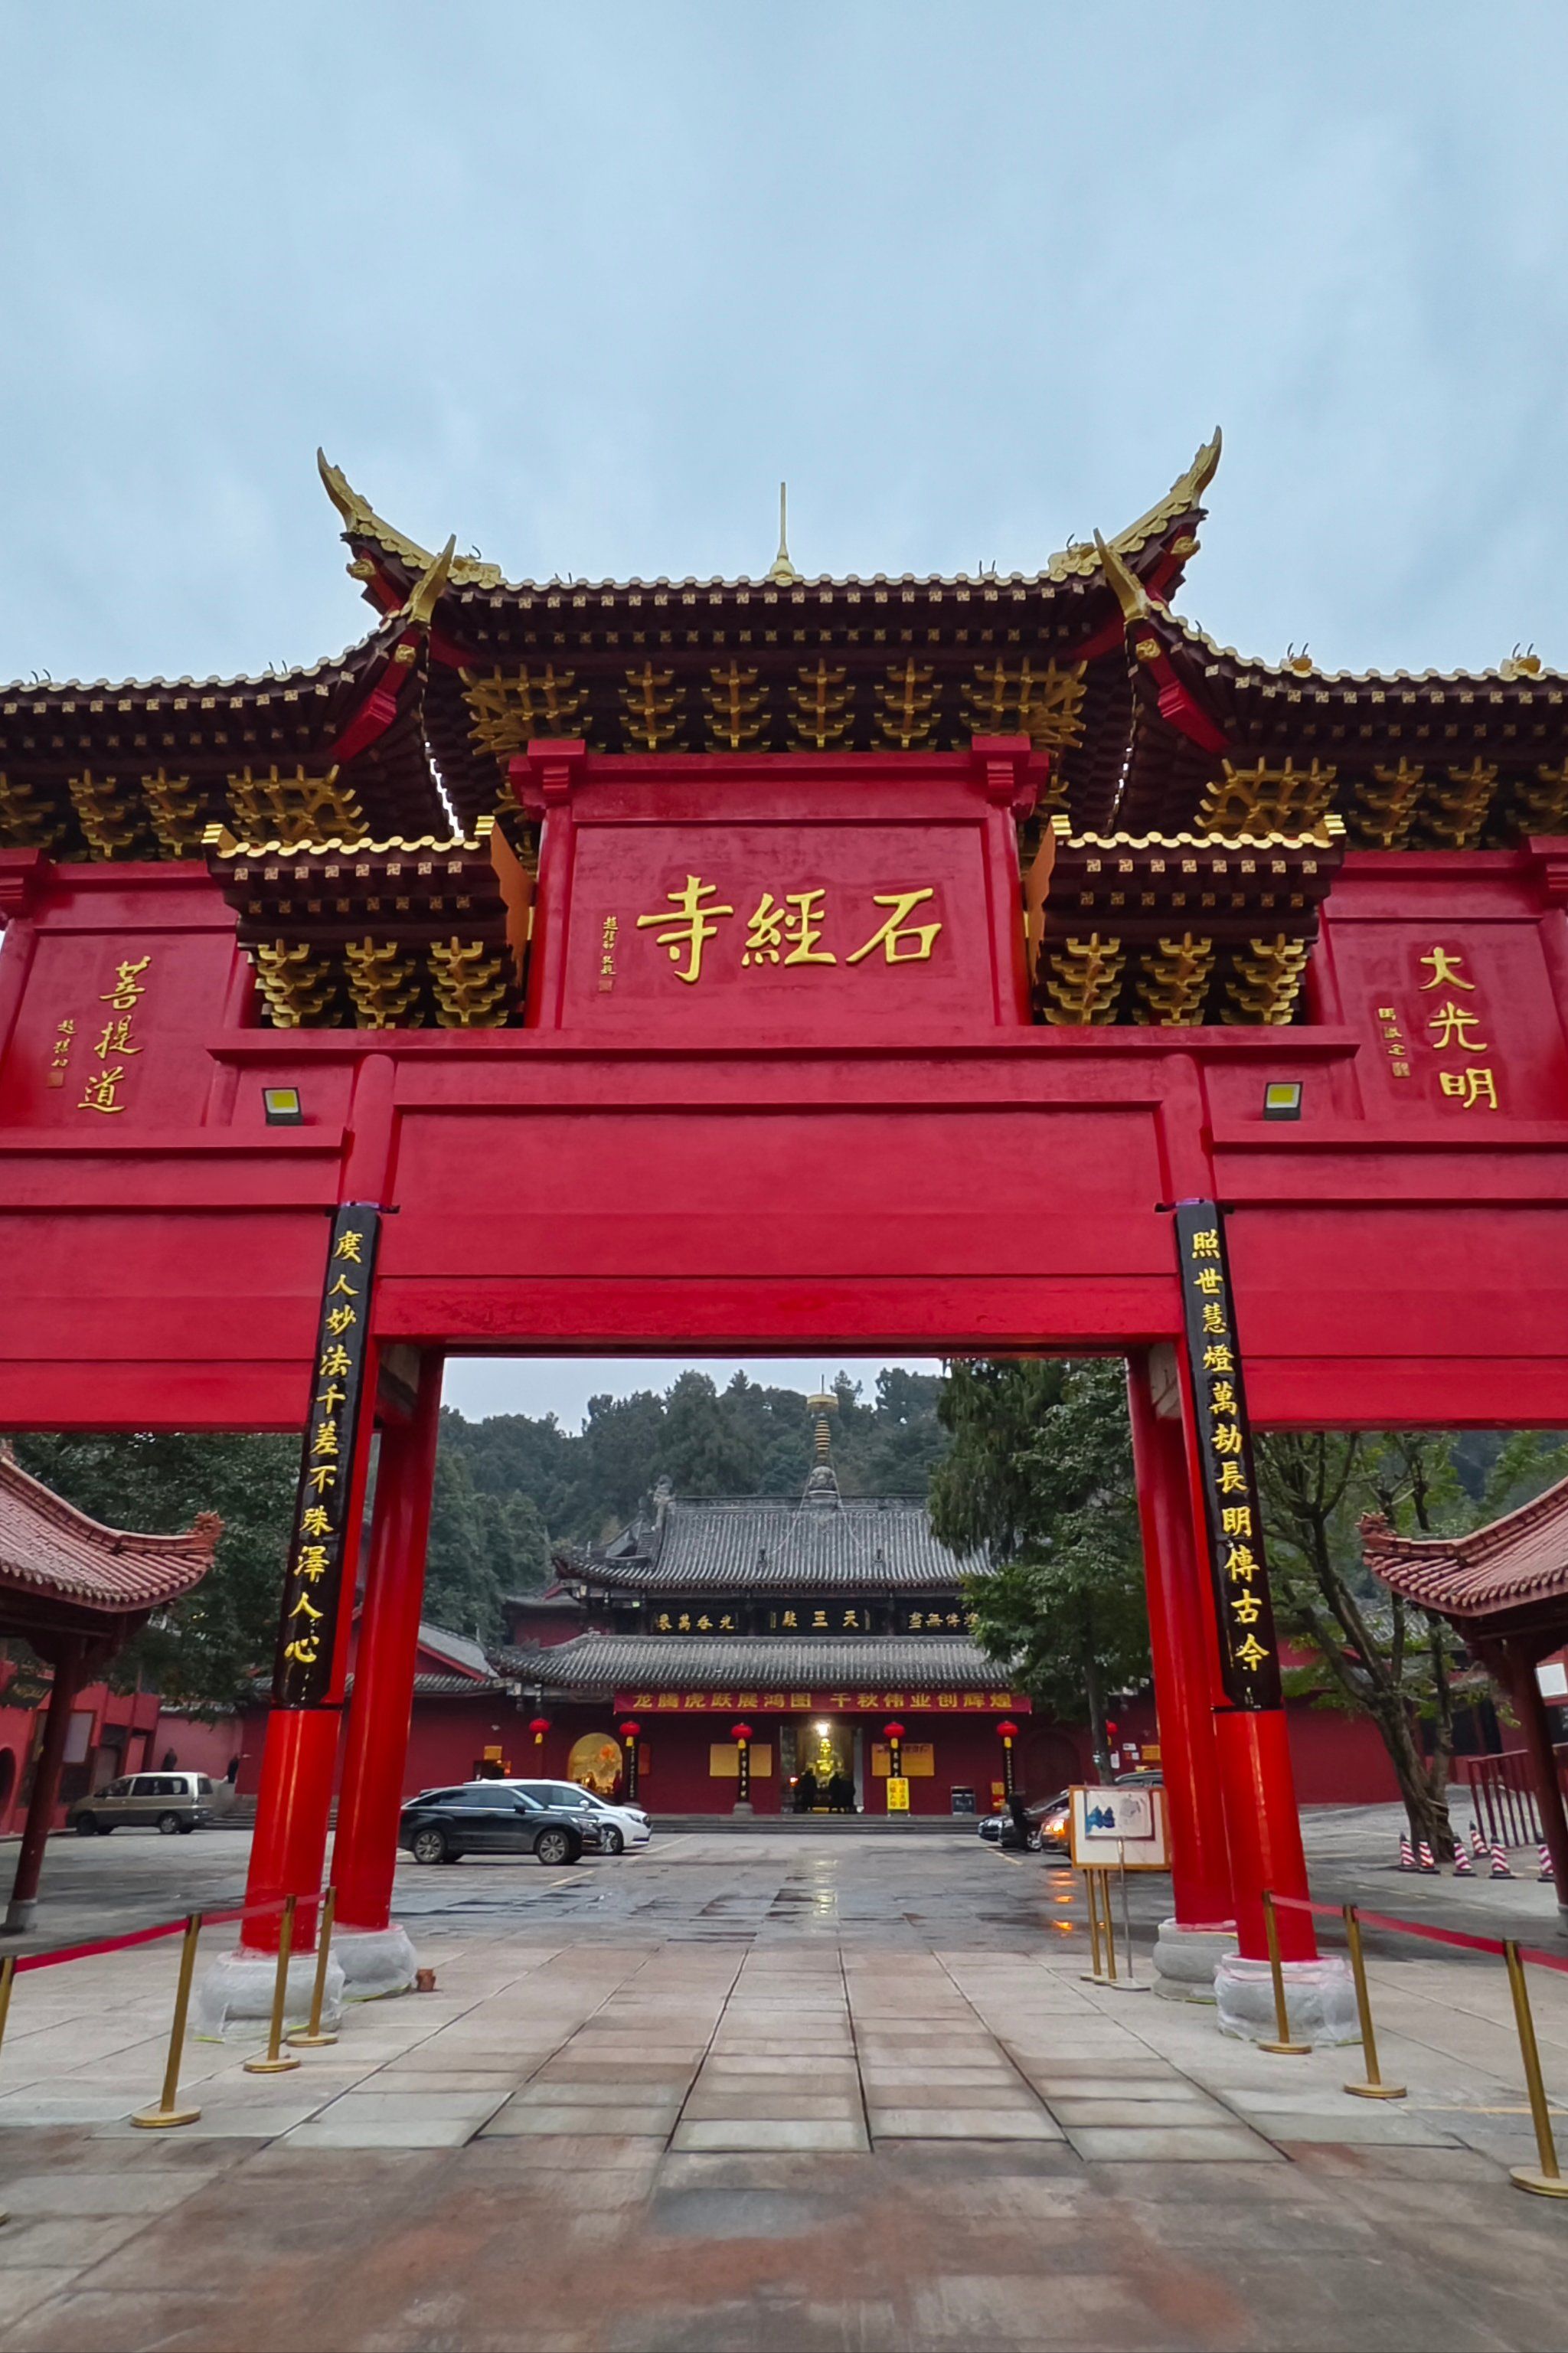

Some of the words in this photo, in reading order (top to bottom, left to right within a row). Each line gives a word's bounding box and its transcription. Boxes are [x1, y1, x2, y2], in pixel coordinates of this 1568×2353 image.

[637, 875, 942, 983] 石經寺
[77, 956, 152, 1113] 菩提道
[1419, 946, 1498, 1110] 大光明
[830, 1692, 1012, 1709] 千秋伟业创辉煌
